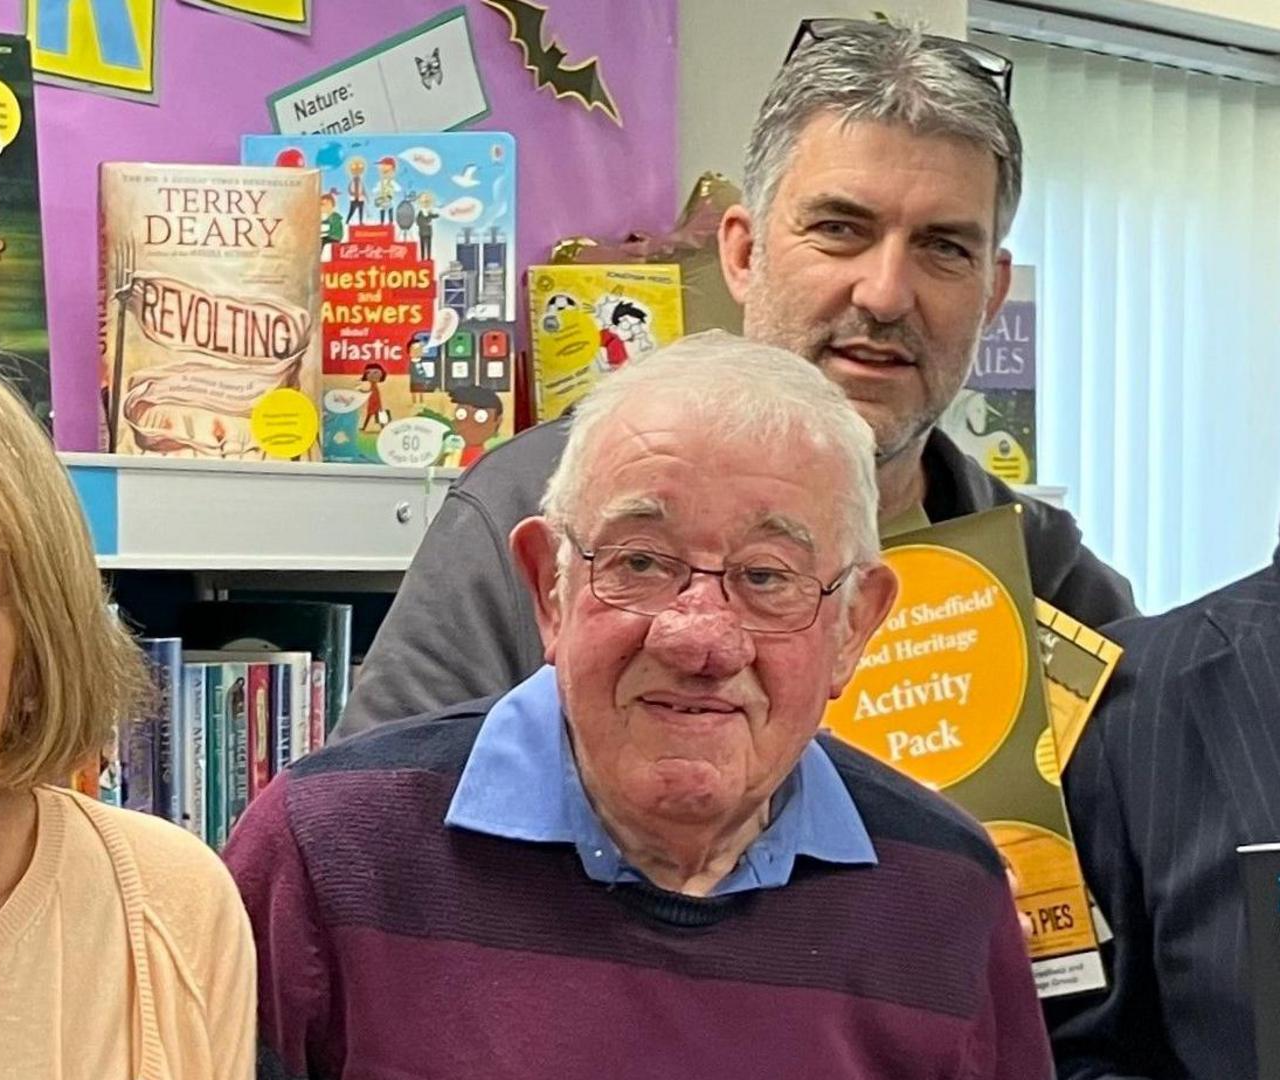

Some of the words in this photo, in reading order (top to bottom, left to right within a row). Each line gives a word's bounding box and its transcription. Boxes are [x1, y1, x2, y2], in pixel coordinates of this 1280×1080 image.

[293, 83, 354, 122] Nature:
[158, 187, 268, 214] TERRY
[144, 214, 284, 249] DEARY
[322, 265, 430, 289] uestions
[141, 280, 291, 360] REVOLTING
[321, 301, 423, 324] Answers
[330, 338, 403, 361] Plastic
[894, 625, 980, 663] Heritage
[852, 671, 975, 722] Activity
[885, 719, 965, 764] Pack
[1038, 903, 1074, 934] PIES
